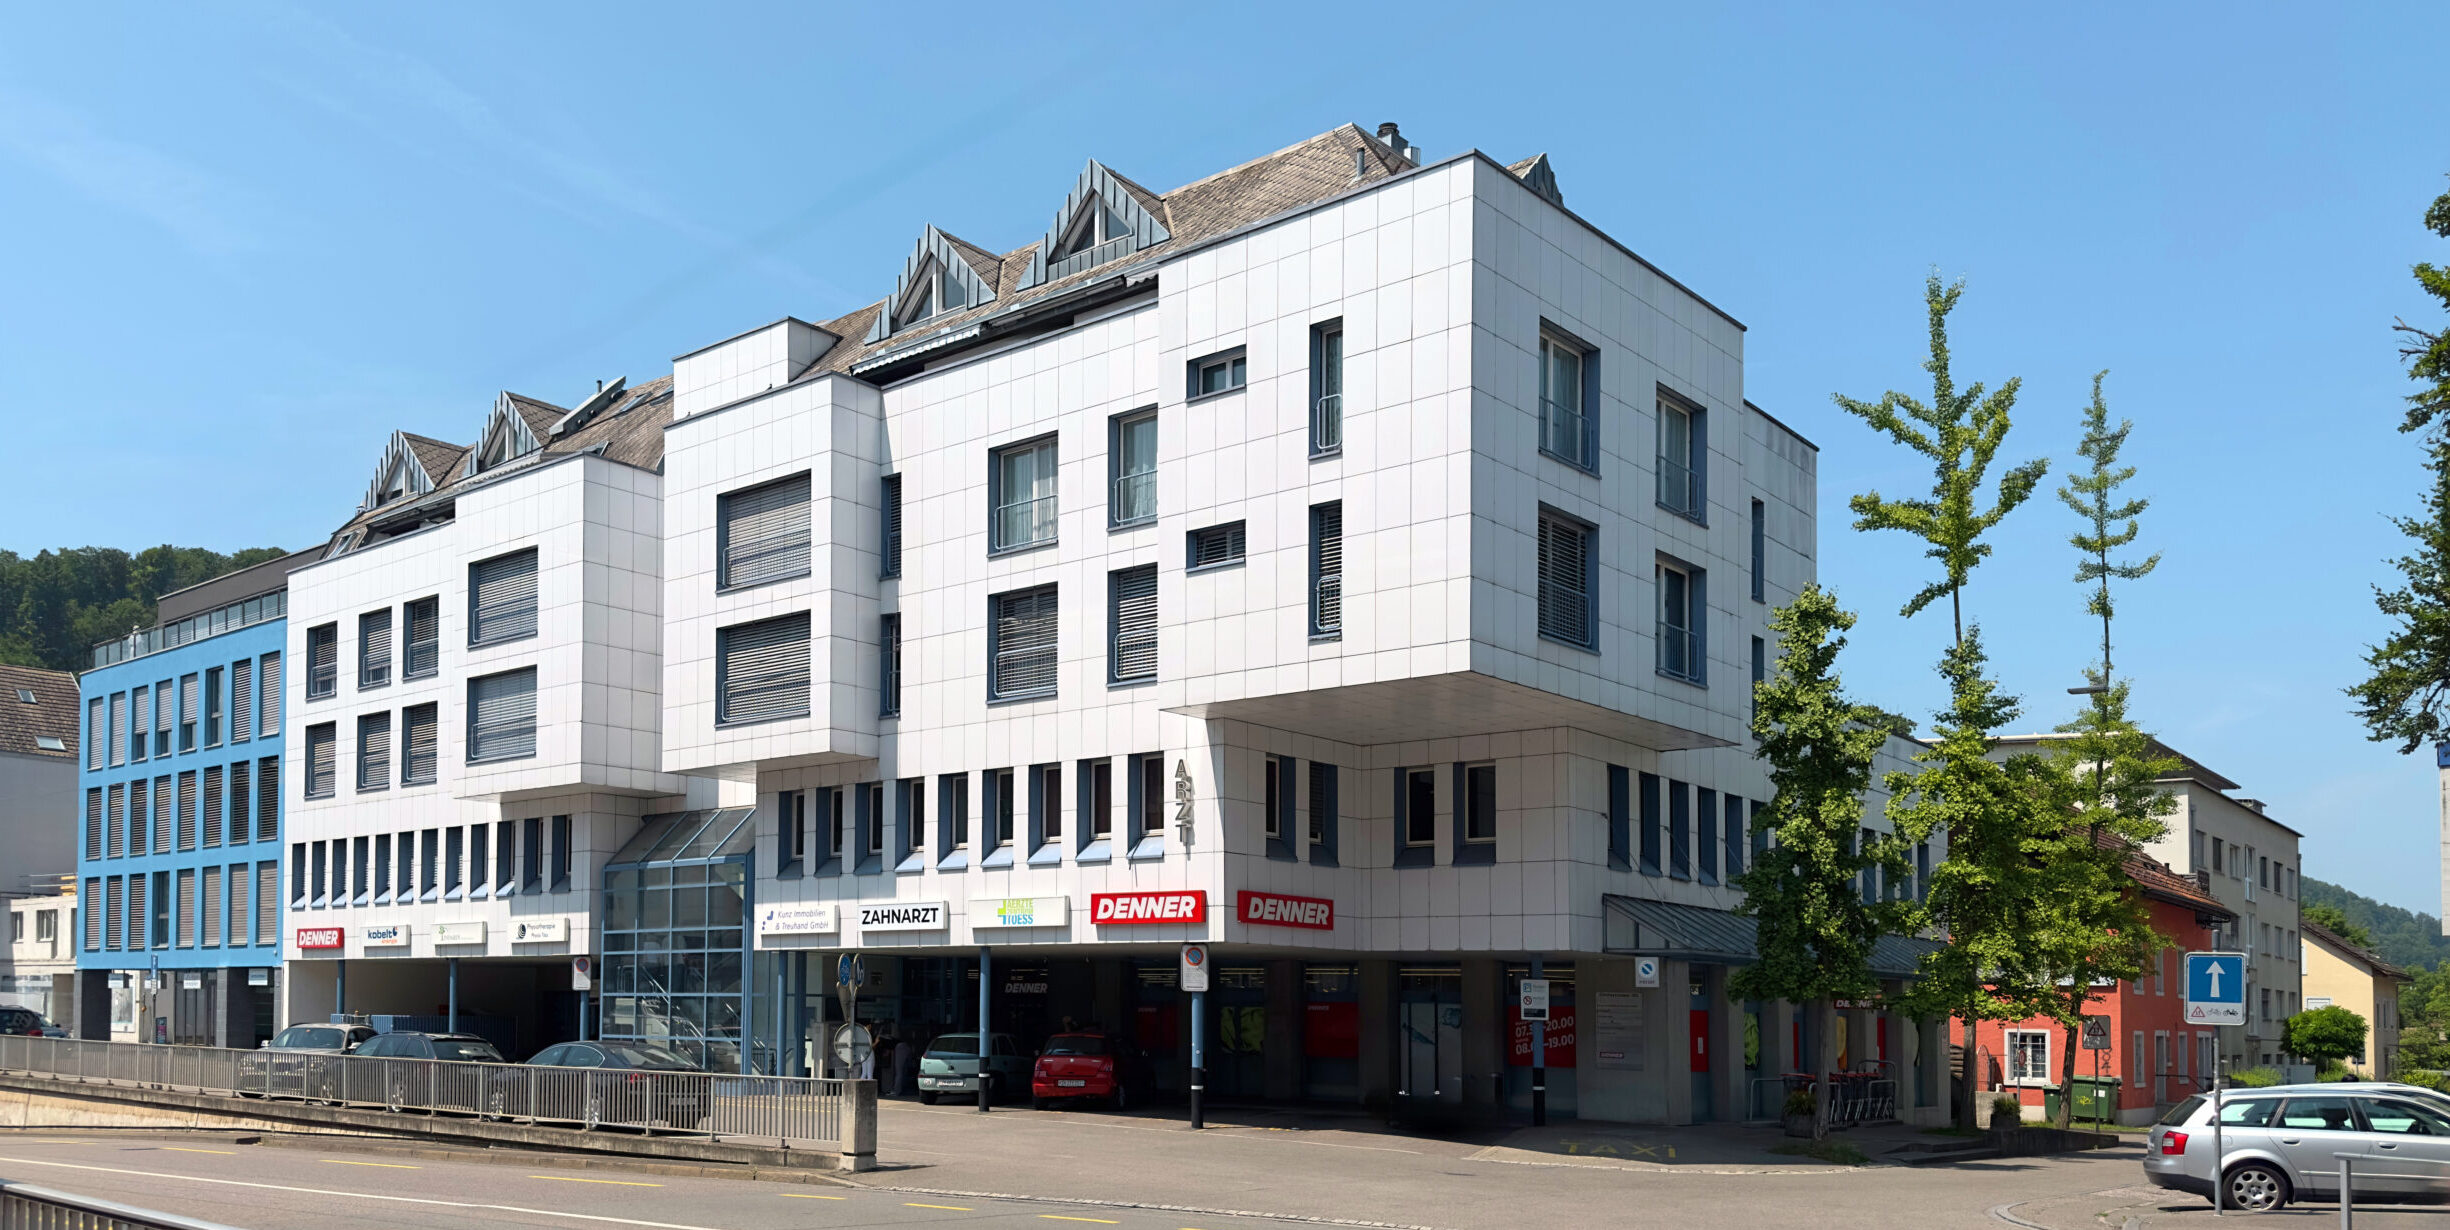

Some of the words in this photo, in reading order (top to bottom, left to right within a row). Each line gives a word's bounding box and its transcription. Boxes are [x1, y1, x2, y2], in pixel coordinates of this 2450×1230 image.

[1175, 759, 1191, 842] ARZT
[1007, 898, 1033, 907] AERZTE
[1097, 895, 1196, 919] DENNER
[777, 911, 792, 919] Kunz
[862, 908, 939, 925] ZAHNARZT
[1248, 897, 1330, 925] DENNER
[782, 921, 808, 930] Treuhand
[810, 920, 829, 929] GmbH
[298, 930, 339, 946] DENNER
[367, 928, 392, 940] kobelt
[1004, 983, 1048, 993] DENNER
[1561, 1139, 1676, 1159] TAXI
